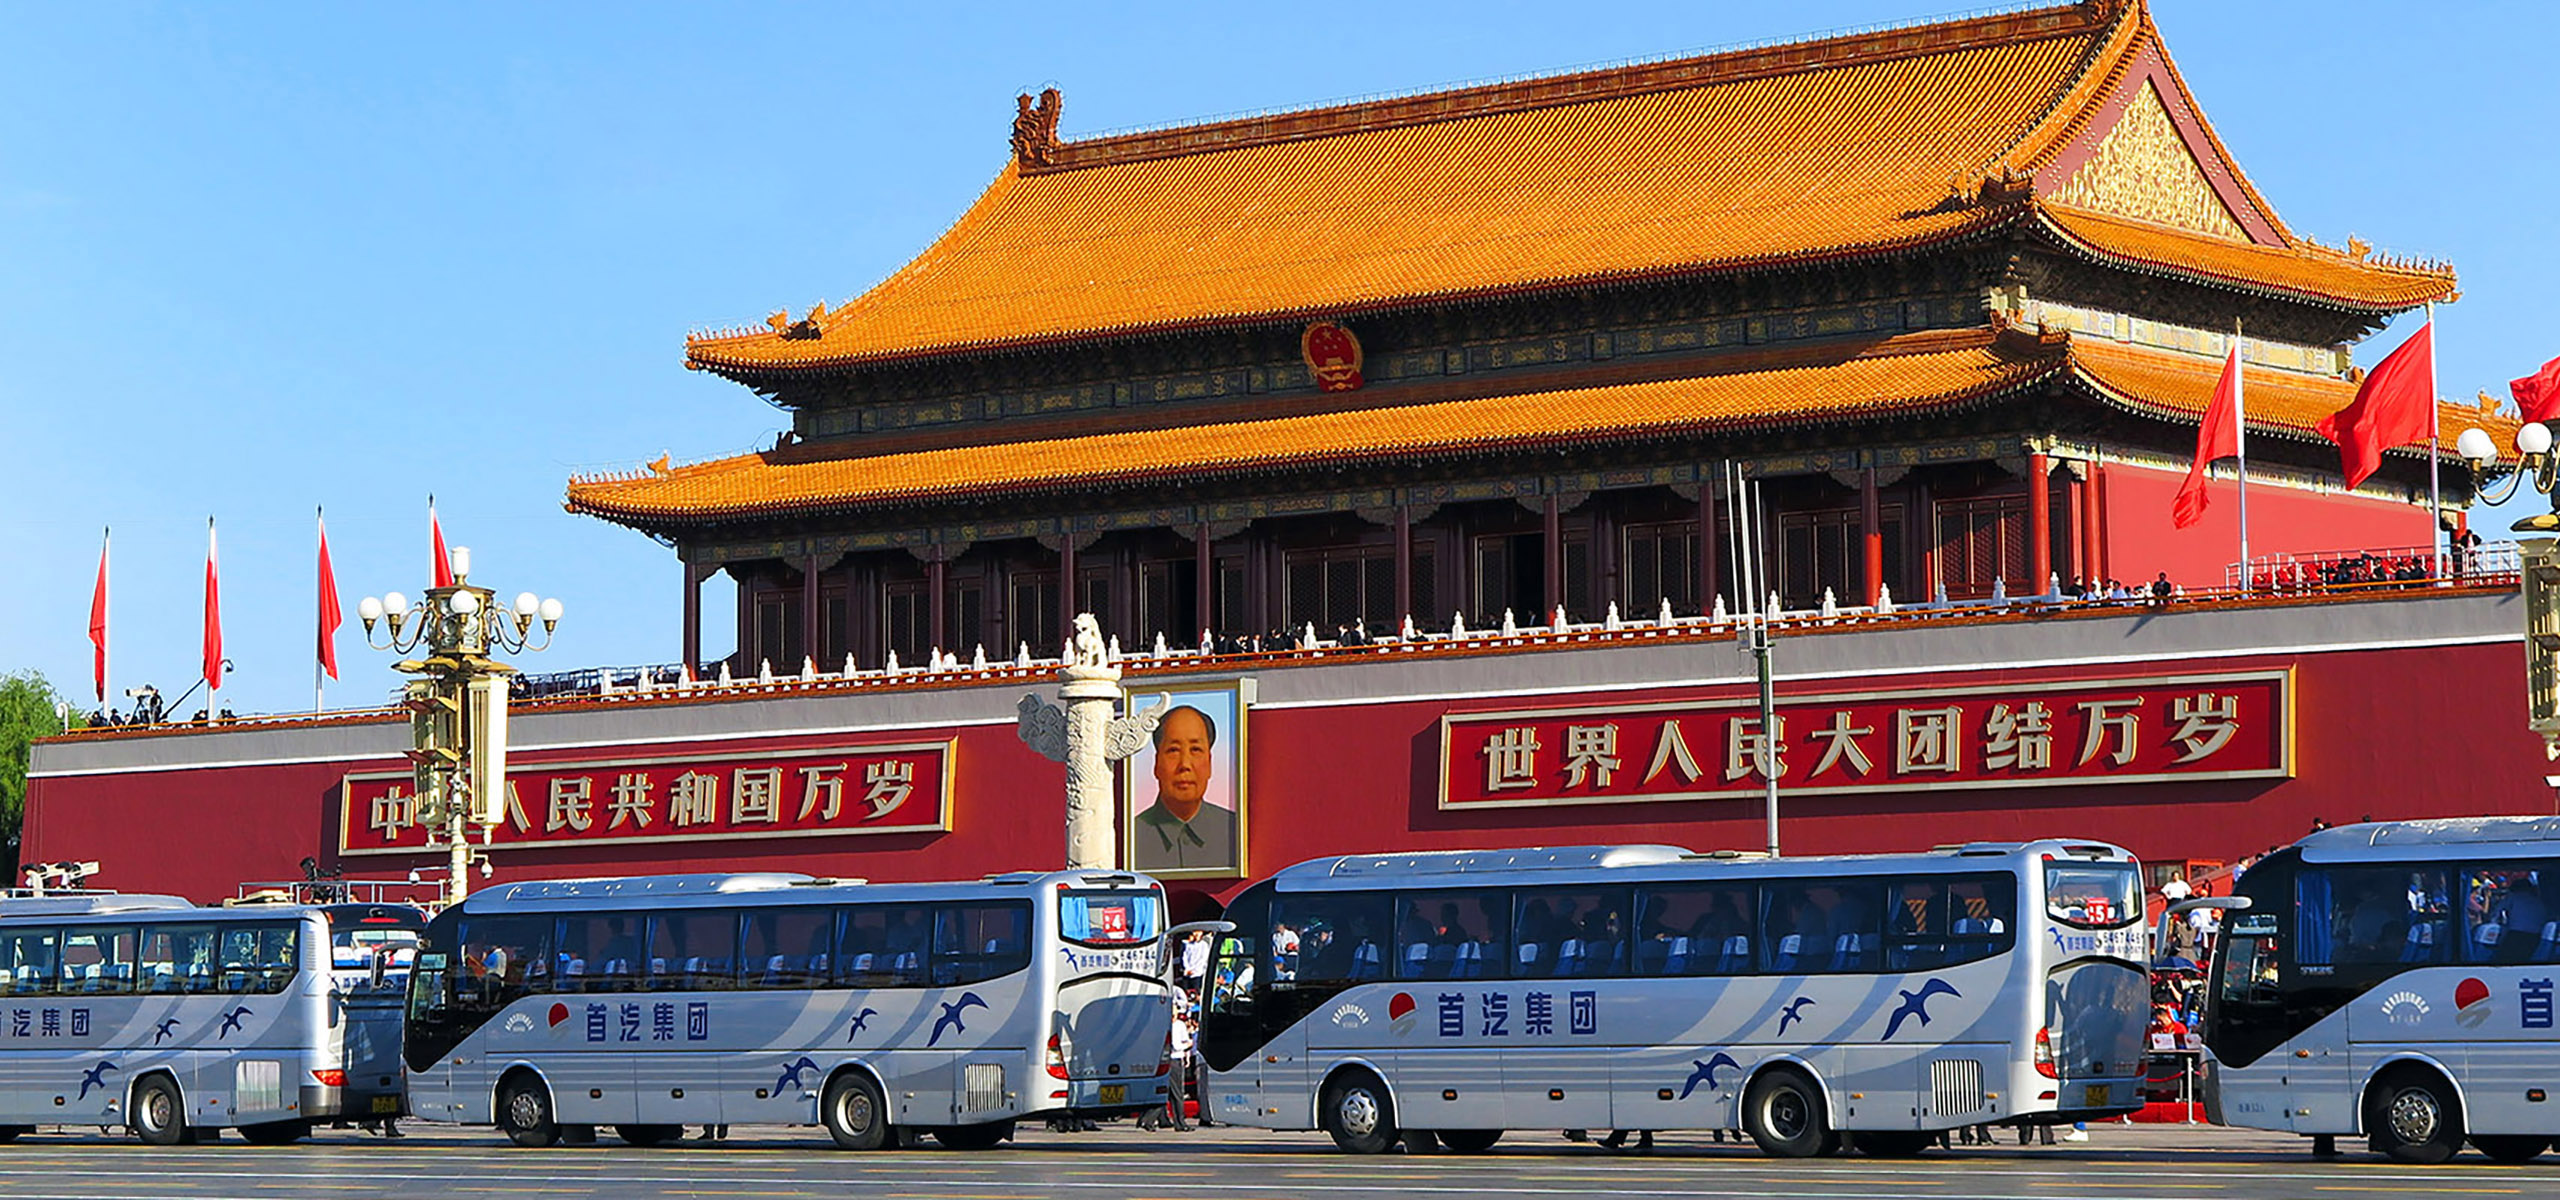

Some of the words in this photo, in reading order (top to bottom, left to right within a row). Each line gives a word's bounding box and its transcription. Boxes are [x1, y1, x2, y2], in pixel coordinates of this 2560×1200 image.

[1483, 692, 2239, 791] 世界人民大团结万岁
[371, 760, 914, 840] 中人民共和国万岁
[0, 1009, 89, 1036] 汽集团
[587, 1003, 708, 1041] 首汽集团
[1438, 991, 1597, 1036] 首汽集团
[2519, 978, 2553, 1028] 首
